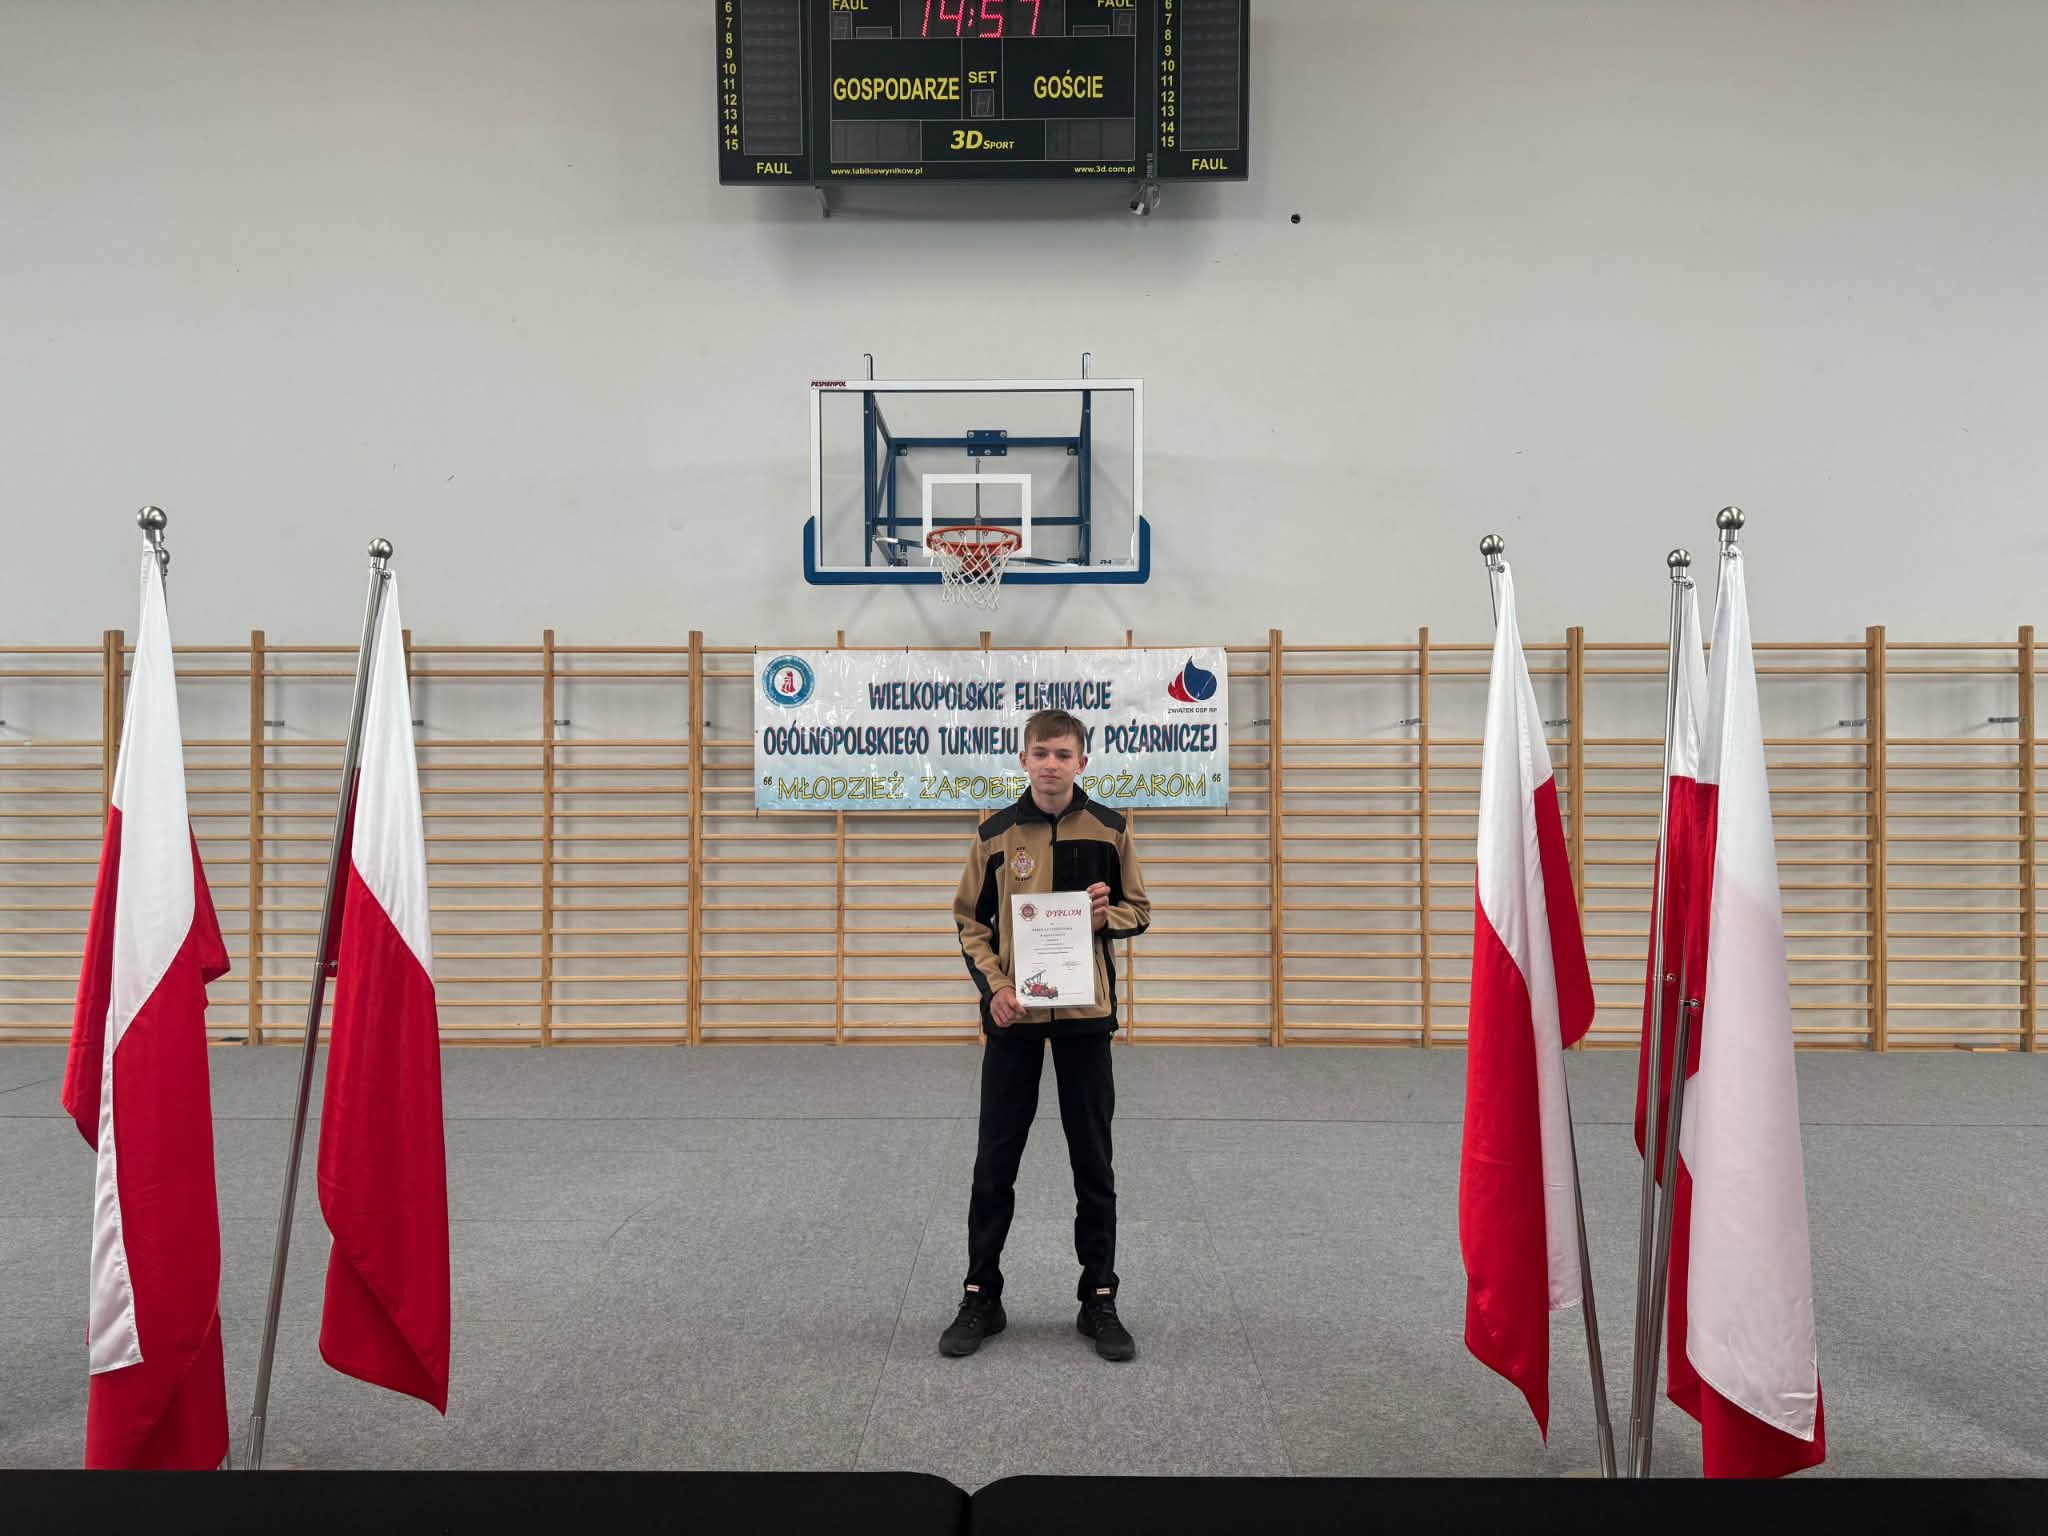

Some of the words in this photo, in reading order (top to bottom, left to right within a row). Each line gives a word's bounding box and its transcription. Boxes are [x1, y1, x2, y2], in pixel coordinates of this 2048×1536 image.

[724, 1, 733, 13] 6
[832, 0, 869, 11] FAUL
[1098, 0, 1134, 9] FAUL
[1164, 0, 1173, 10] 6
[725, 16, 733, 29] 7
[922, 0, 1041, 38] 14:57
[1164, 13, 1173, 26] 7
[725, 32, 733, 44] 8
[1164, 28, 1172, 41] 8
[725, 47, 733, 59] 9
[1164, 44, 1172, 57] 9
[723, 62, 737, 75] 10
[1161, 60, 1176, 72] 10
[723, 78, 736, 90] 11
[968, 71, 998, 84] SET
[1033, 69, 1104, 99] GOŚCIE
[1160, 75, 1174, 87] 11
[833, 77, 961, 101] GOSPODARZE
[724, 93, 738, 106] 12
[1160, 90, 1175, 103] 12
[724, 108, 738, 121] 13
[1160, 105, 1175, 117] 13
[724, 124, 738, 136] 14
[1160, 121, 1175, 133] 14
[725, 139, 739, 151] 15
[1160, 135, 1175, 148] 15
[756, 162, 793, 175] FAUL
[1191, 158, 1228, 171] FAUL
[869, 682, 1006, 711] WIELKOPOLSKIE
[1015, 680, 1112, 711] ELIMINACJE
[763, 720, 930, 755] OGÓLNOPOLSKIEGO
[938, 726, 1018, 755] TURNIEJU
[1105, 719, 1217, 754] POŻARNICZEJ
[919, 775, 1028, 800] ZAPOBIE
[1045, 908, 1082, 918] DYPLOM
